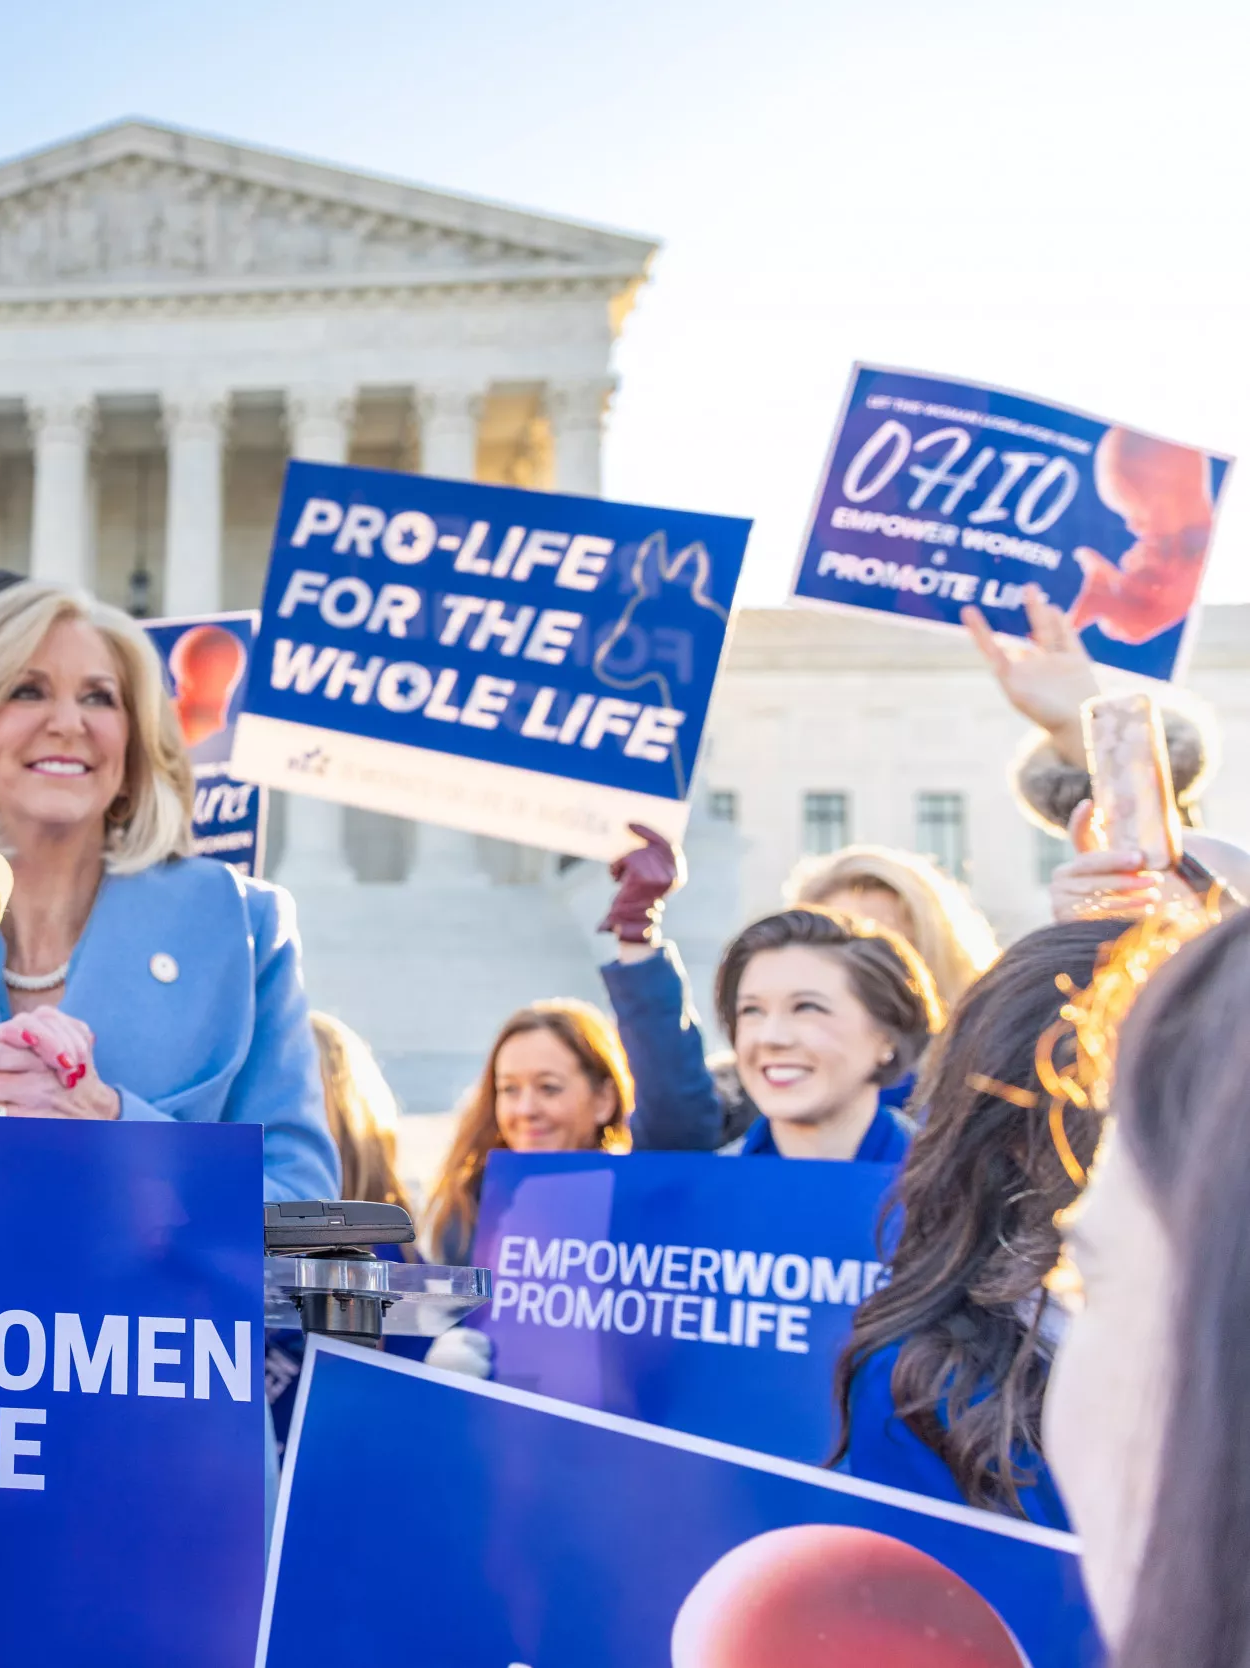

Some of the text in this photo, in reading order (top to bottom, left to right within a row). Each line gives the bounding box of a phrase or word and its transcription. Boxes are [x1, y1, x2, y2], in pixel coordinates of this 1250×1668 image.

[841, 419, 1080, 536] OHIO
[290, 498, 615, 592] PRO-LIFE
[817, 551, 980, 602] PROMOTE
[830, 507, 1063, 570] EMPOWER WOMEN
[275, 569, 582, 665] FOR THE
[269, 639, 687, 764] WHOLE LIFE
[490, 1279, 811, 1355] PROMOTELIFE
